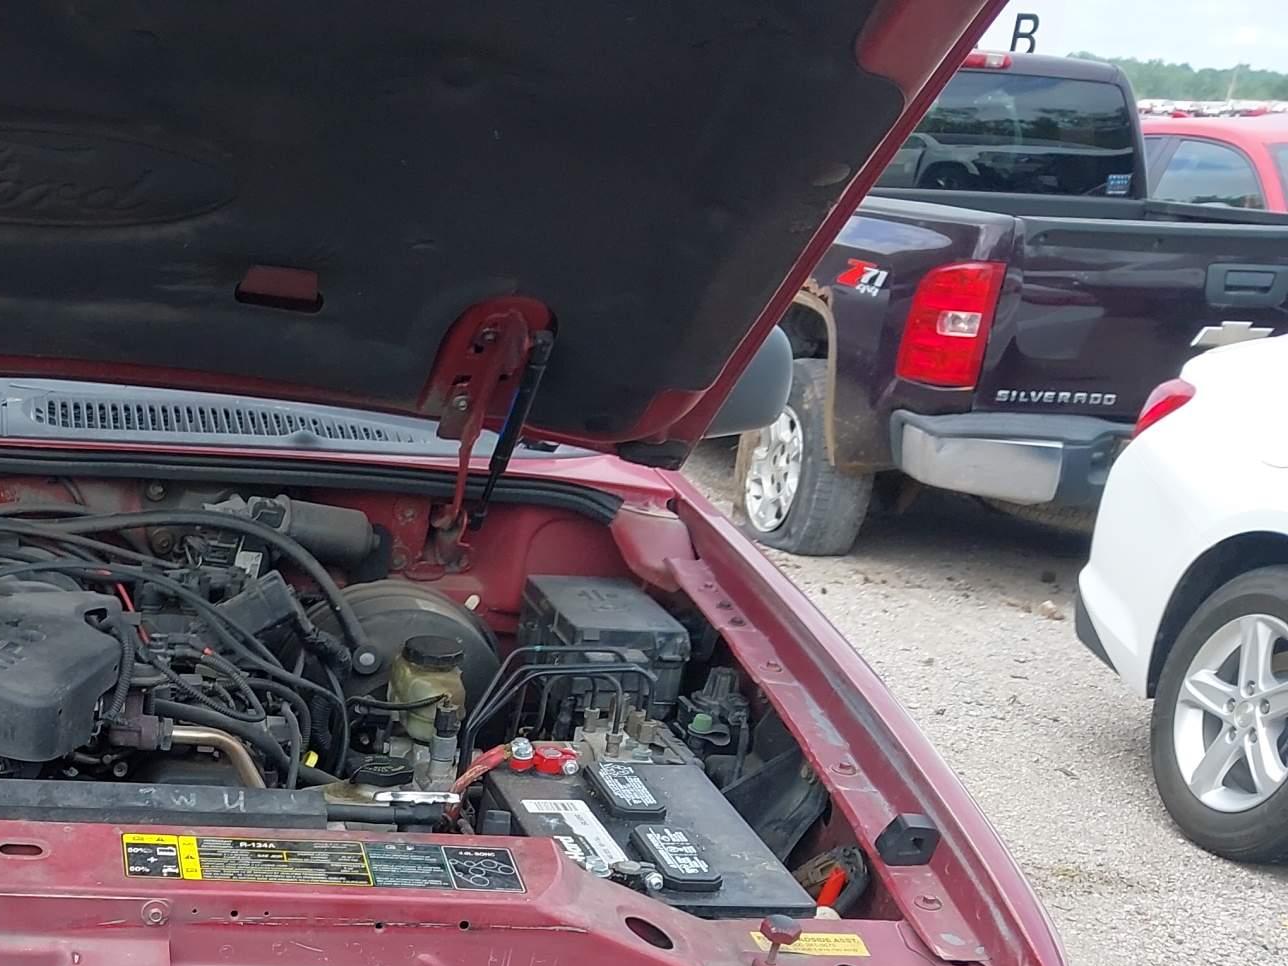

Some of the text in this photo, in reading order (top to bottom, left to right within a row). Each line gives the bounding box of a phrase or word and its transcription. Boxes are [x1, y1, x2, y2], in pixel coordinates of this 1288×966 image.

[836, 258, 888, 289] Z71
[995, 389, 1117, 405] SILVERADO
[239, 841, 276, 850] R-134A
